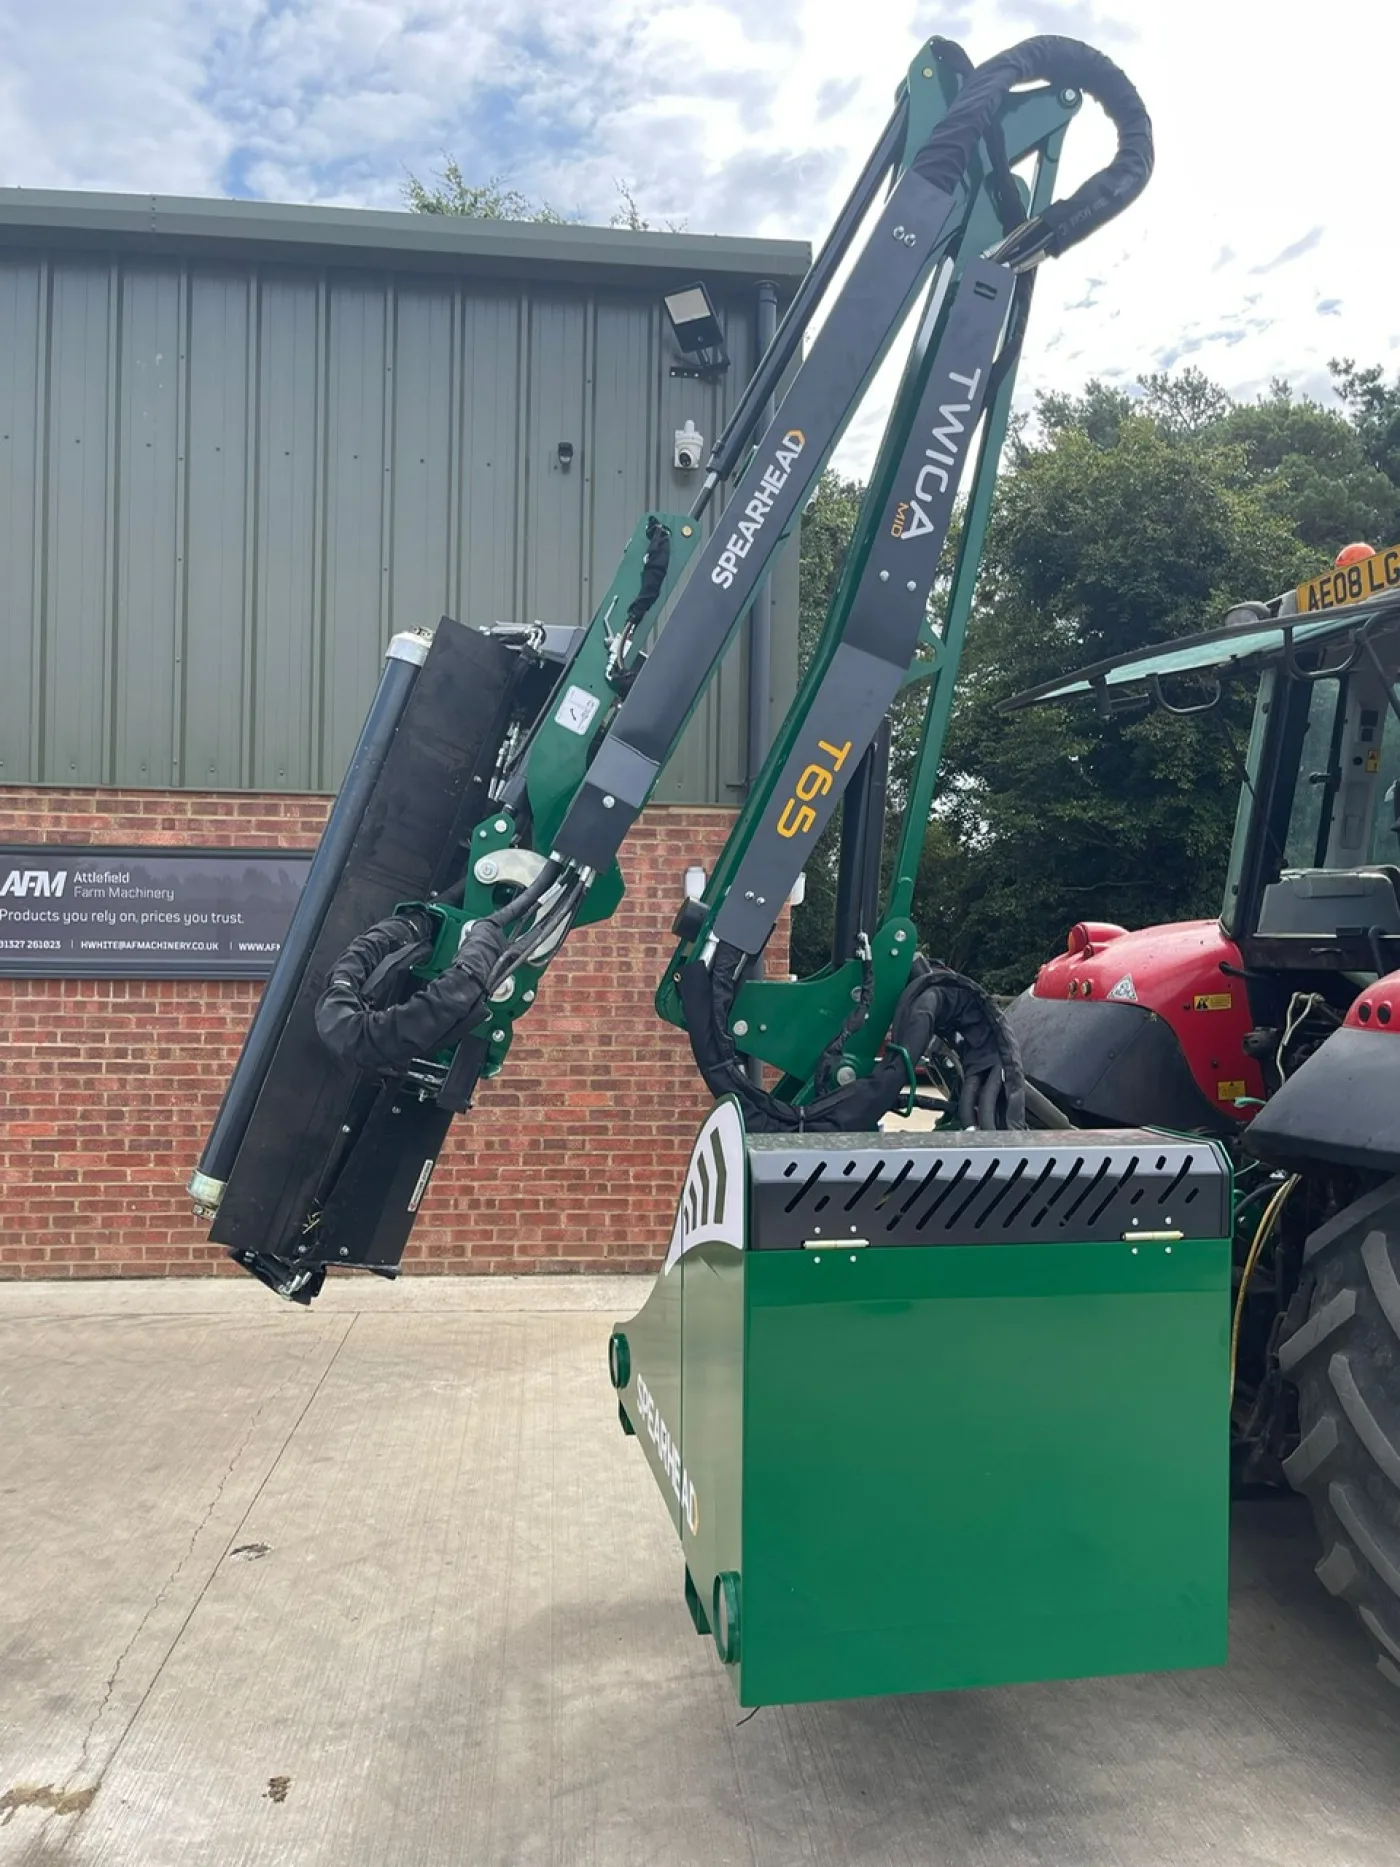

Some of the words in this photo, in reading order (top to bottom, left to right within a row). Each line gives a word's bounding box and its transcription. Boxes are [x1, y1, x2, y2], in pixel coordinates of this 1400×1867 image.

[711, 429, 806, 589] SPEARHEAD
[890, 502, 910, 538] MID
[1308, 566, 1362, 612] AE08
[776, 740, 852, 838] T65
[0, 870, 68, 898] AFM
[73, 871, 130, 884] Attlefield
[74, 886, 106, 898] Farm
[108, 886, 174, 901] Machinery
[0, 908, 60, 922] Products
[63, 912, 88, 925] you
[91, 910, 116, 925] rely
[140, 910, 181, 925] prices
[184, 912, 208, 926] you
[210, 912, 244, 924] trust.
[81, 940, 219, 951] HWHITE@AFMACHINERY.CO.UK
[636, 1373, 699, 1537] SPEARHEAD
